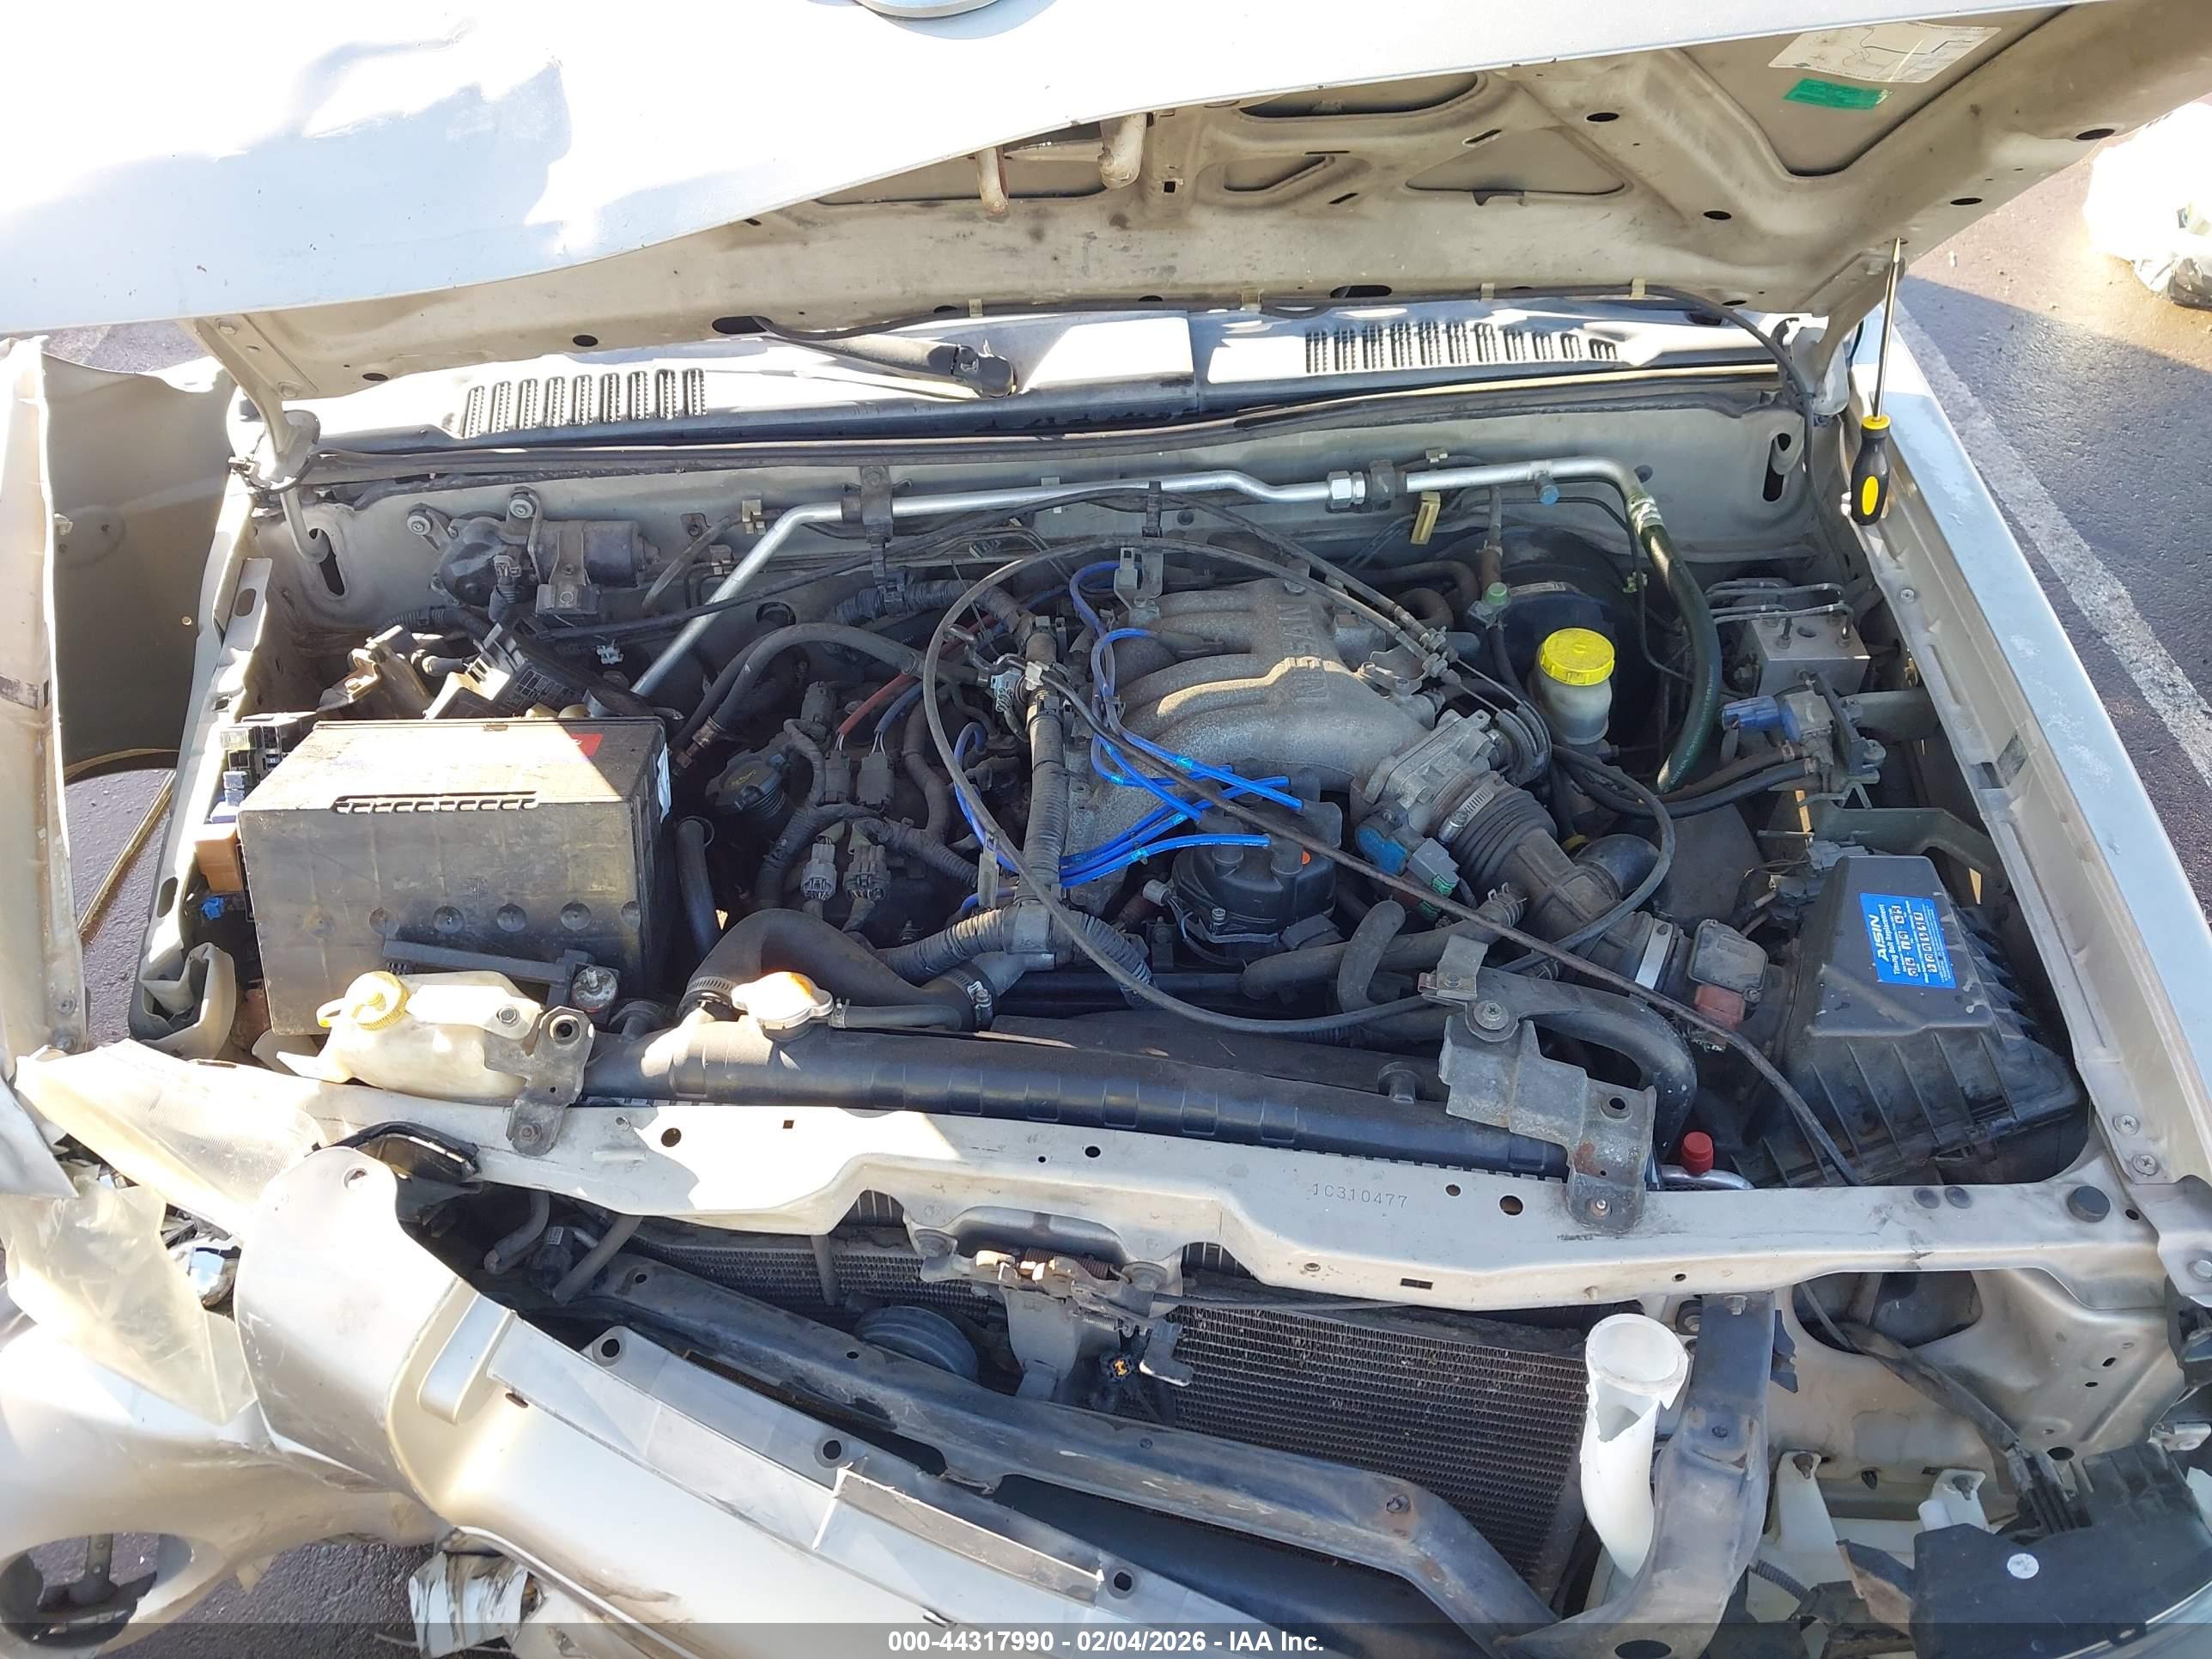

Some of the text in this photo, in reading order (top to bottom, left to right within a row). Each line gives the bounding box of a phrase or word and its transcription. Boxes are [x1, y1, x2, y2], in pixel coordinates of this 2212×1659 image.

[1277, 604, 1330, 700] NISSAN
[1878, 903, 1893, 940] Replacement
[1868, 914, 1889, 962] AISIN
[1887, 941, 1896, 953] Belt
[1891, 954, 1901, 975] Timing
[1313, 1183, 1407, 1207] 1C310477
